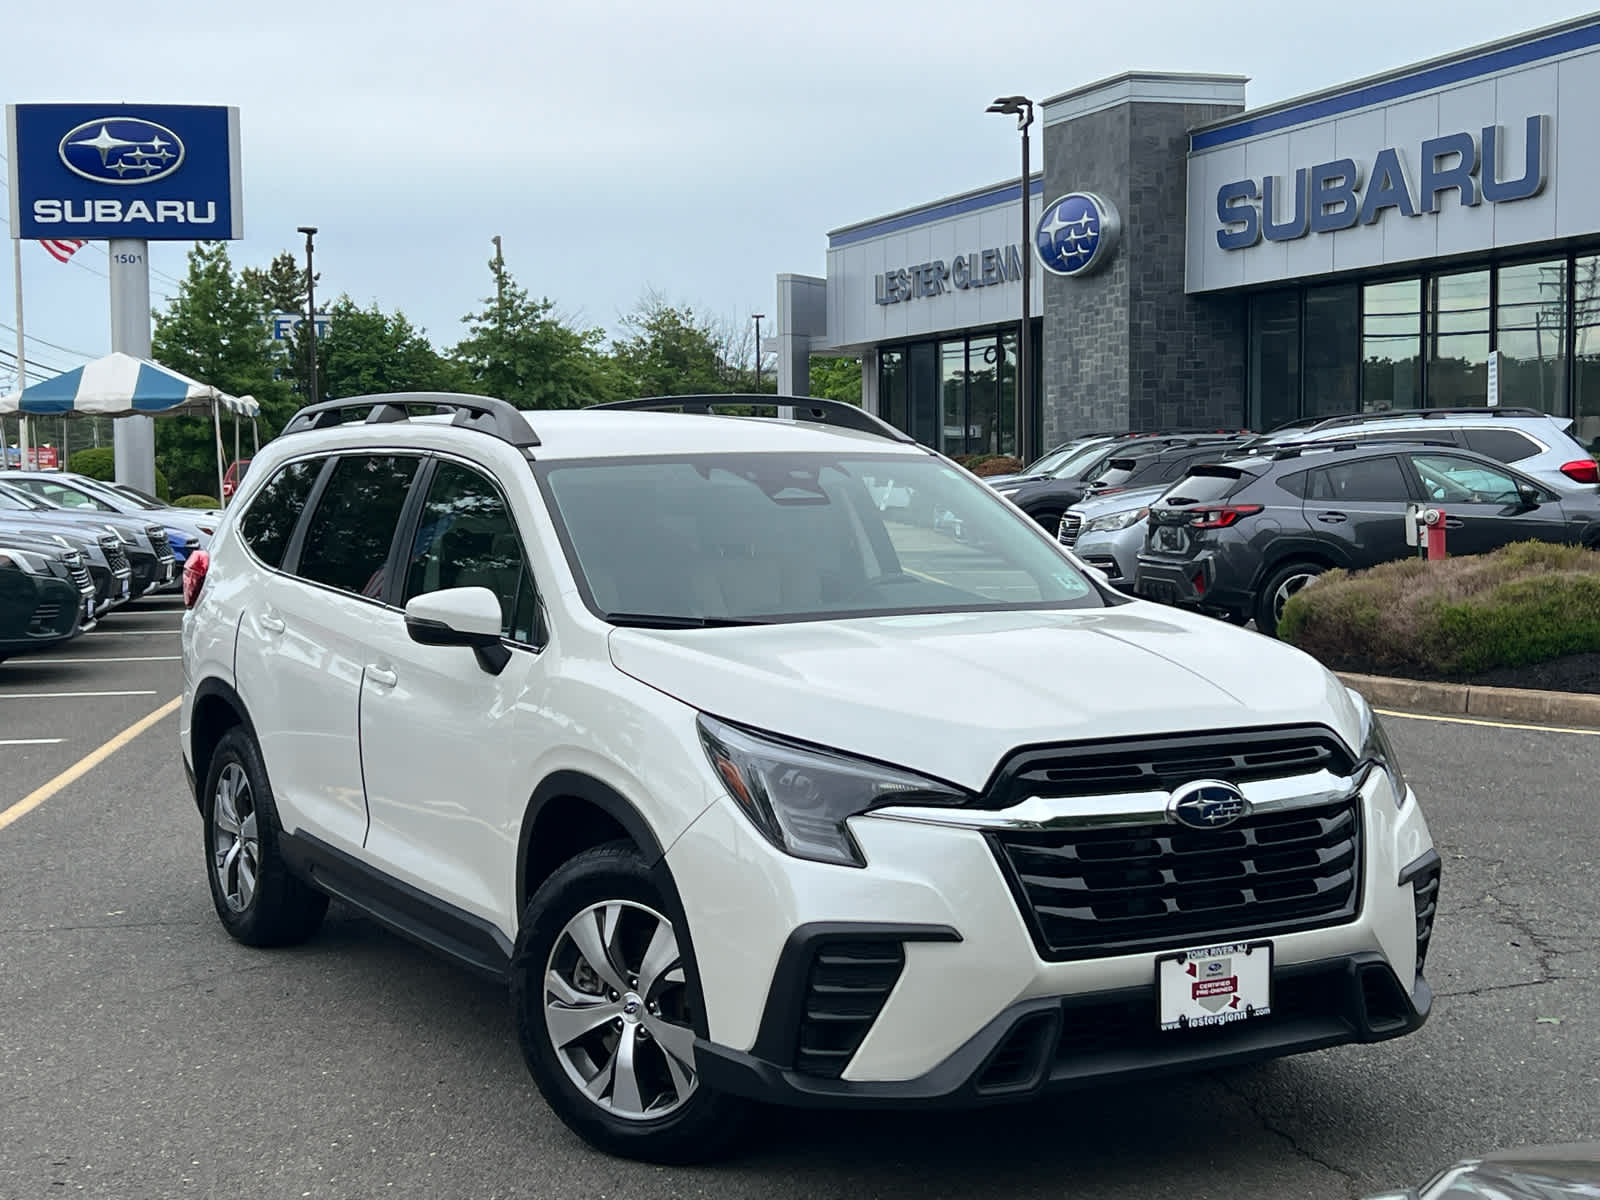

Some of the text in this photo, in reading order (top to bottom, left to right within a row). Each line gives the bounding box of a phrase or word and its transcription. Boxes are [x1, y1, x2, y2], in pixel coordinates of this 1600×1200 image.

[1216, 114, 1547, 251] SUBARU
[33, 199, 216, 224] SUBARU
[114, 254, 143, 264] 1501
[875, 244, 1023, 305] LESTER GLENN
[1186, 949, 1209, 960] TOMS
[1237, 944, 1248, 953] NJ
[1196, 986, 1234, 996] PRE-OWNED
[1199, 980, 1231, 989] CERTIFIED
